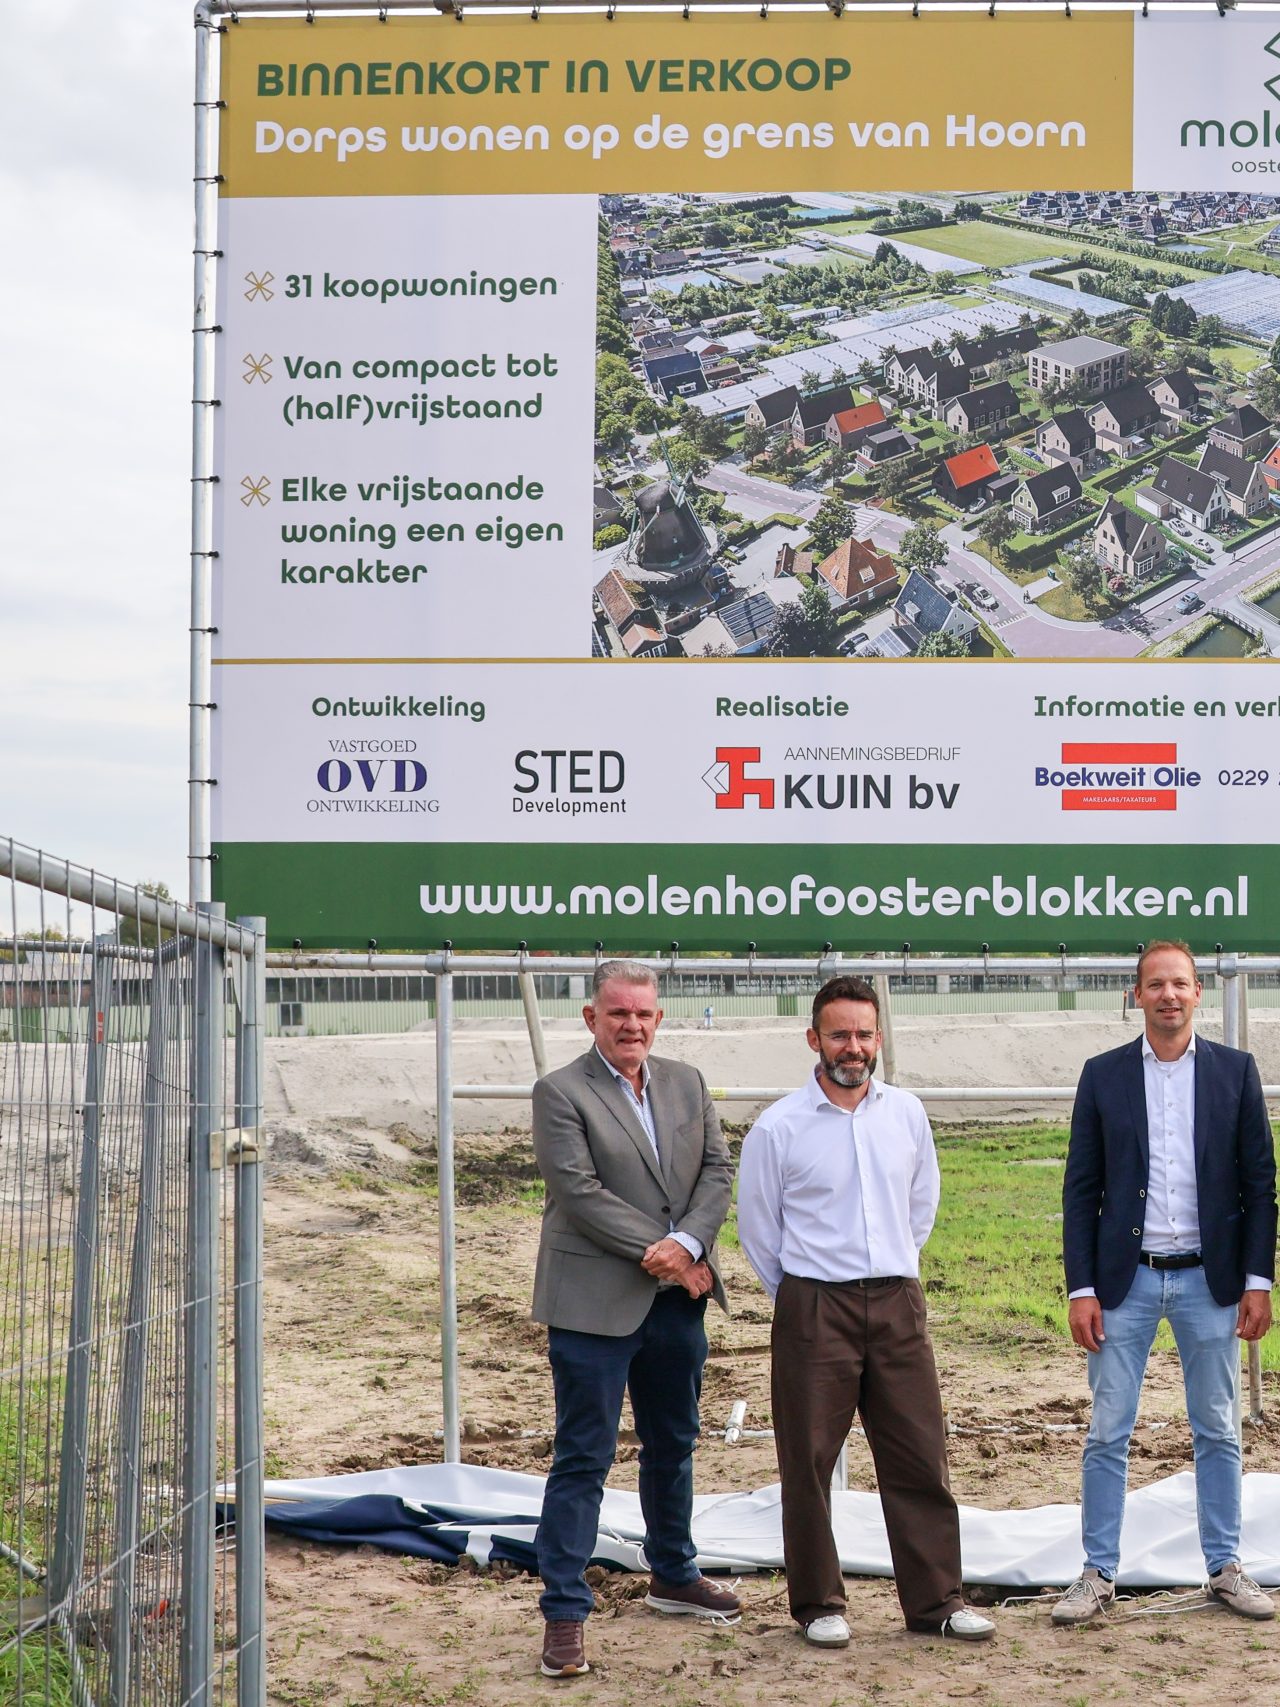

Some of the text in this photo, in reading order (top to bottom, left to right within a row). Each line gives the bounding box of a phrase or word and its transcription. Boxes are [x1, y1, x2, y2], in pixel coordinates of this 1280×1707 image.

[257, 58, 851, 96] BINNENKORT IN VERKOOP
[256, 114, 1086, 162] Dorps wonen op de grens van Hoorn
[285, 271, 556, 303] 31 koopwoningen
[284, 353, 558, 384] Van compact tot
[283, 393, 542, 426] (half)vrijstaand
[283, 475, 543, 508] Elke vrijstaande
[282, 516, 563, 549] woning een eigen
[282, 558, 427, 583] karakter
[312, 695, 485, 722] Ontwikkeling
[717, 695, 849, 716] Realisatie
[1035, 695, 1185, 716] Informatie
[1194, 701, 1225, 716] en
[329, 740, 416, 752] VASTGOED
[784, 747, 960, 760] AANNEMINGSBEDRIJF
[317, 759, 427, 792] OVD
[514, 750, 624, 793] STED
[1035, 767, 1201, 786] Boekweit Olie
[1219, 770, 1269, 785] 0229
[307, 800, 439, 812] ONTWIKKELING
[785, 775, 960, 809] KUIN bv
[1082, 796, 1157, 804] MAKELAARS/TAXATEURS
[513, 798, 626, 816] Development
[420, 874, 1247, 916] www.molenhofoosterblokker.nl
